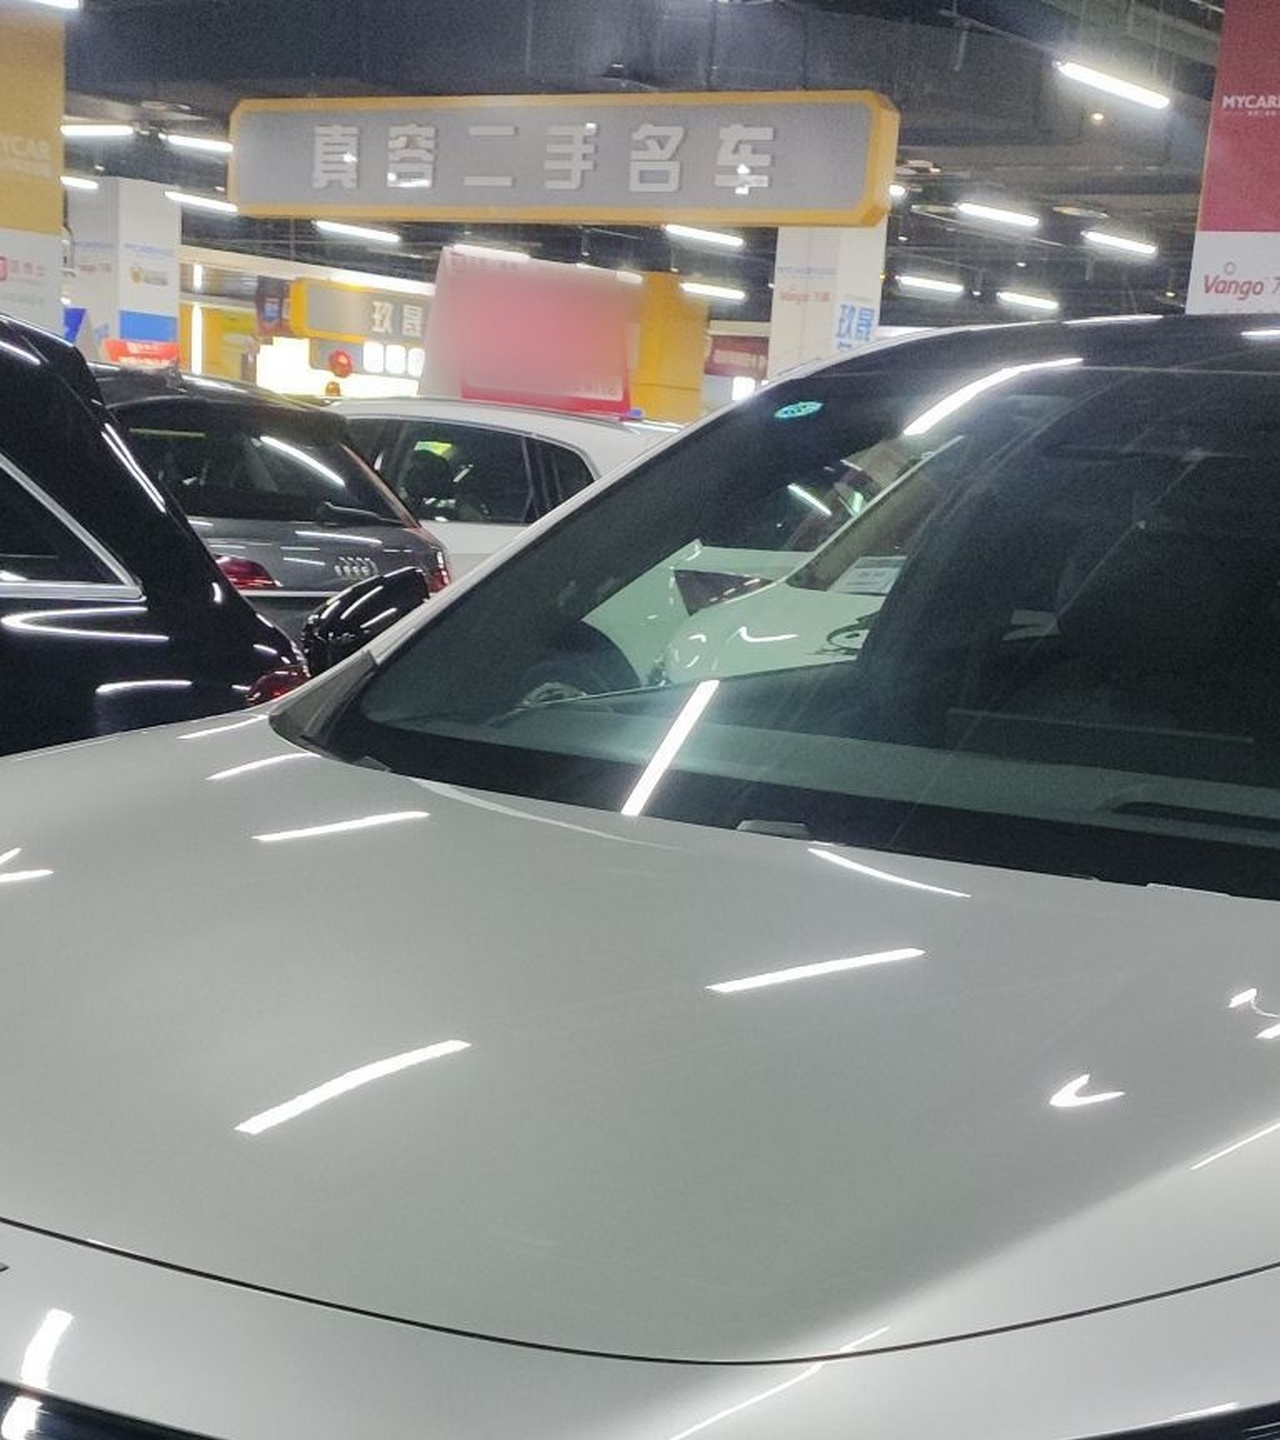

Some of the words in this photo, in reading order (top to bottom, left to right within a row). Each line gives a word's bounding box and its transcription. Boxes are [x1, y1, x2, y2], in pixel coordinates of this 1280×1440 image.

[312, 123, 776, 195] 真容二手名车
[1203, 275, 1265, 301] Vango
